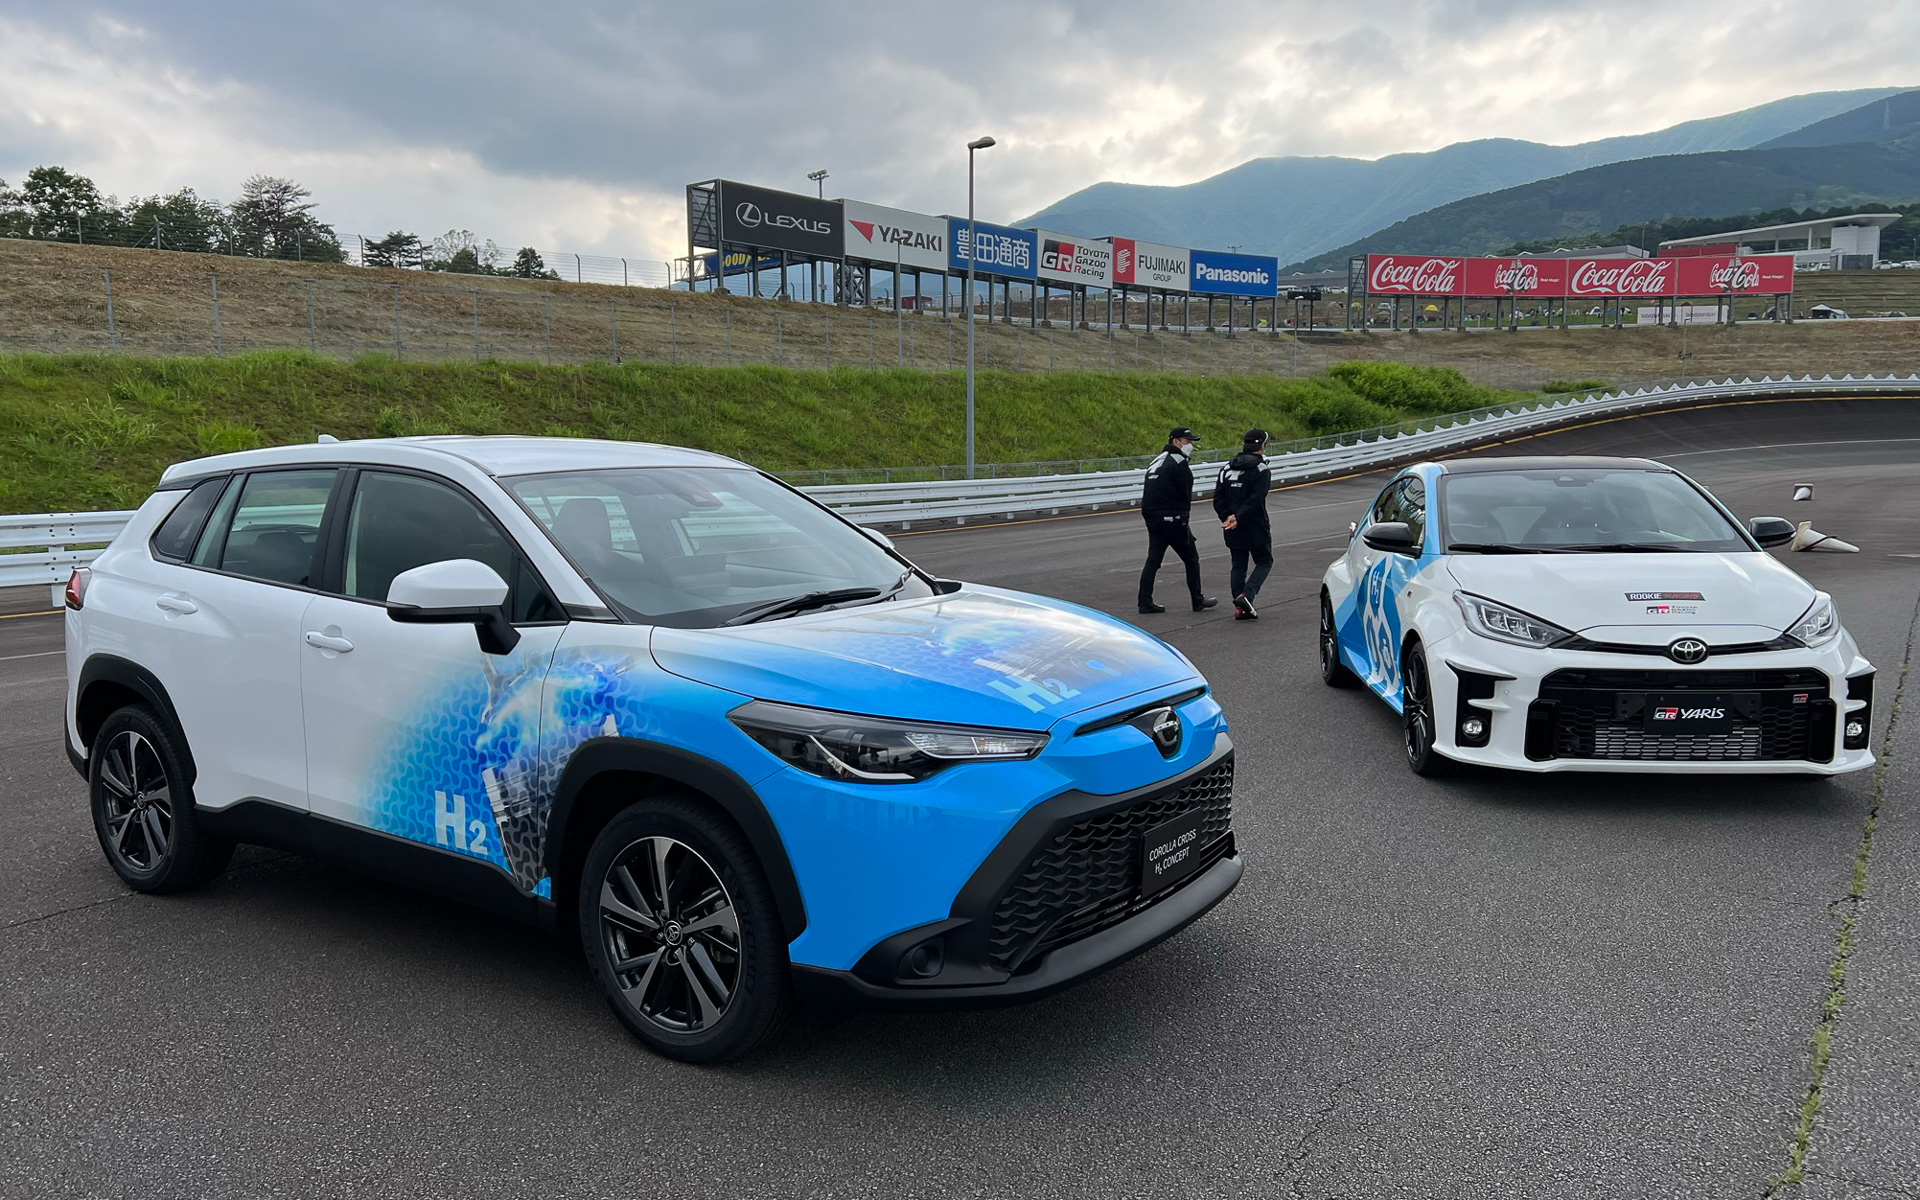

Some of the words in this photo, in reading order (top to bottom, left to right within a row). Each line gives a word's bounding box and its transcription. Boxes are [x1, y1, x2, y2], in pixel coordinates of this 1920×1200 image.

[765, 212, 831, 234] LEXUS
[877, 224, 943, 252] YAZAKI
[956, 228, 1030, 269] 豊田通商
[1075, 256, 1106, 269] GAZOO
[1076, 245, 1110, 260] TOYOTA
[1073, 265, 1105, 280] Racing
[1137, 254, 1187, 276] FUJIMAKI
[1195, 262, 1269, 285] Panasonic
[1371, 257, 1461, 291] Coca-Cola
[1571, 259, 1672, 293] Coca-Cola
[1152, 273, 1172, 283] GROUP
[1630, 592, 1662, 600] ROOKIE
[1680, 707, 1726, 719] YARIS
[434, 790, 488, 856] H2
[1149, 839, 1177, 862] COROLLA
[1177, 828, 1197, 847] CROSS
[1163, 846, 1190, 869] CONCEPT
